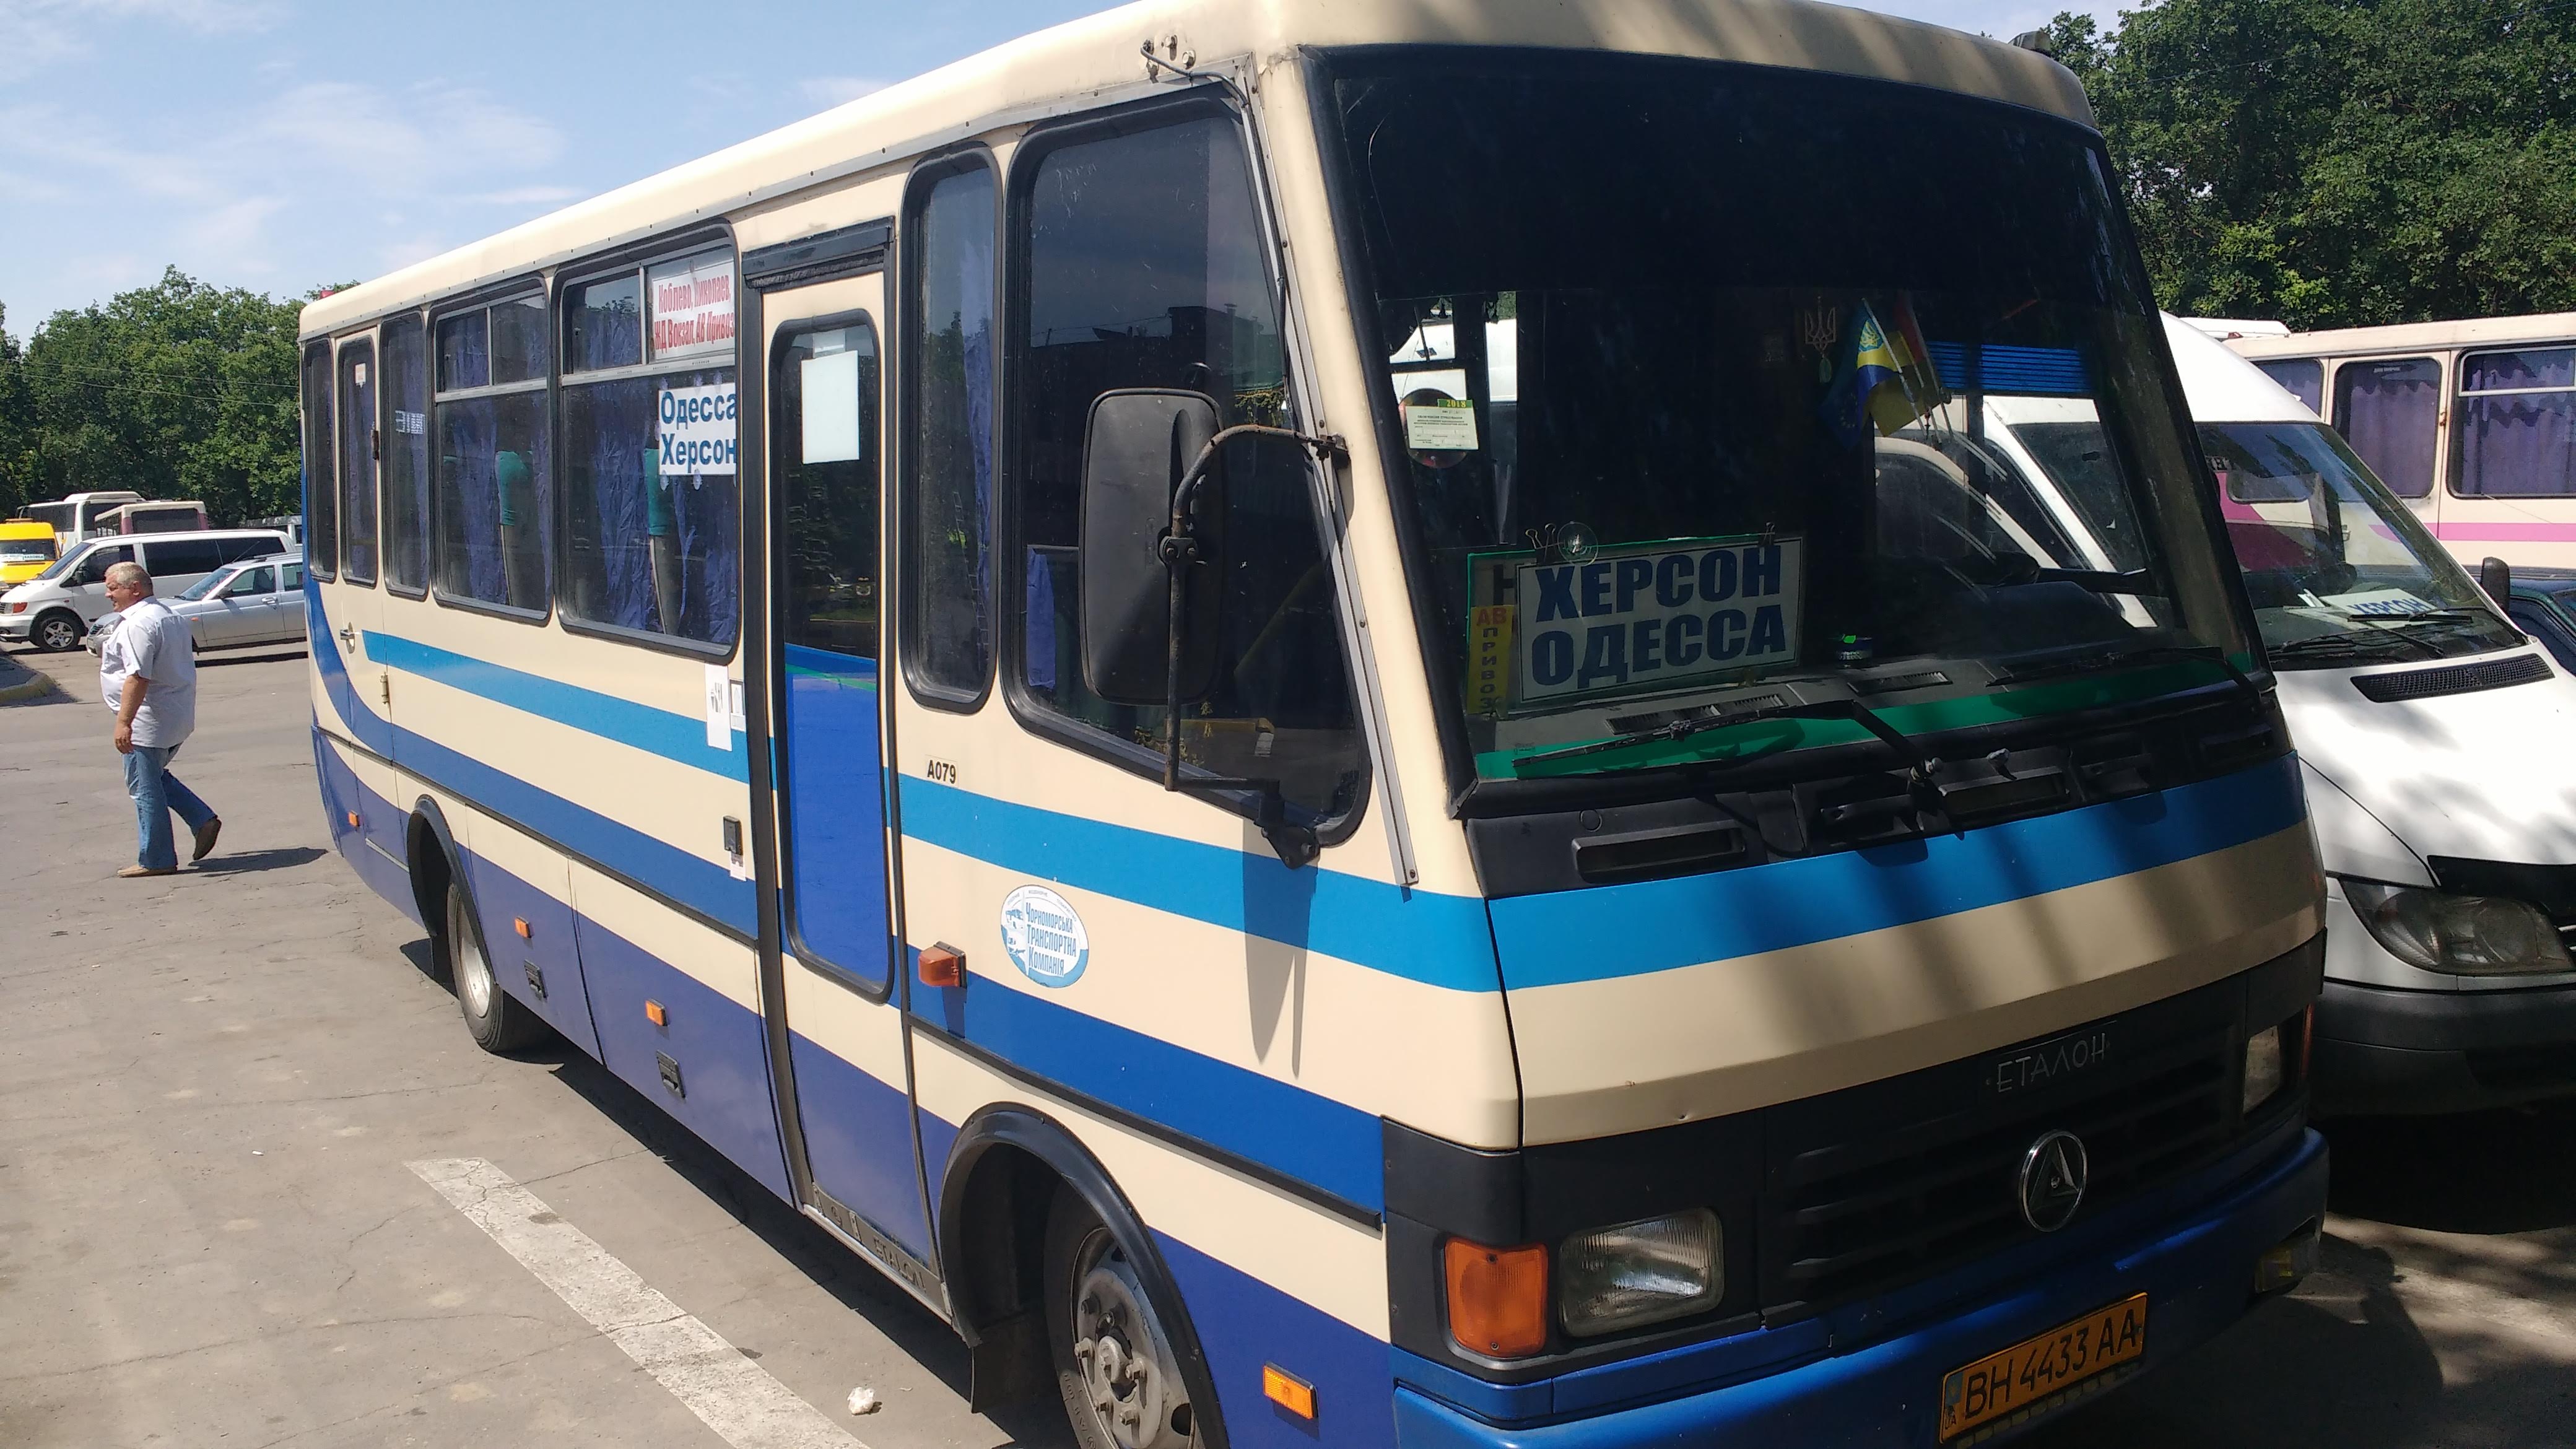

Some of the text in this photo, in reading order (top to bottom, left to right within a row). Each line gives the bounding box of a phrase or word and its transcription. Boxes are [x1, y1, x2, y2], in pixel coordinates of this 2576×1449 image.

[655, 320, 668, 354] ЖД
[661, 391, 736, 430] Одесса
[1447, 399, 1466, 407] 2018
[661, 433, 737, 474] Херсон
[1534, 545, 1782, 623] ХЕРСОН
[1476, 607, 1507, 627] АВ
[1531, 604, 1786, 689] ОДЕССА
[1965, 1308, 2136, 1420] BH 4433 AA
